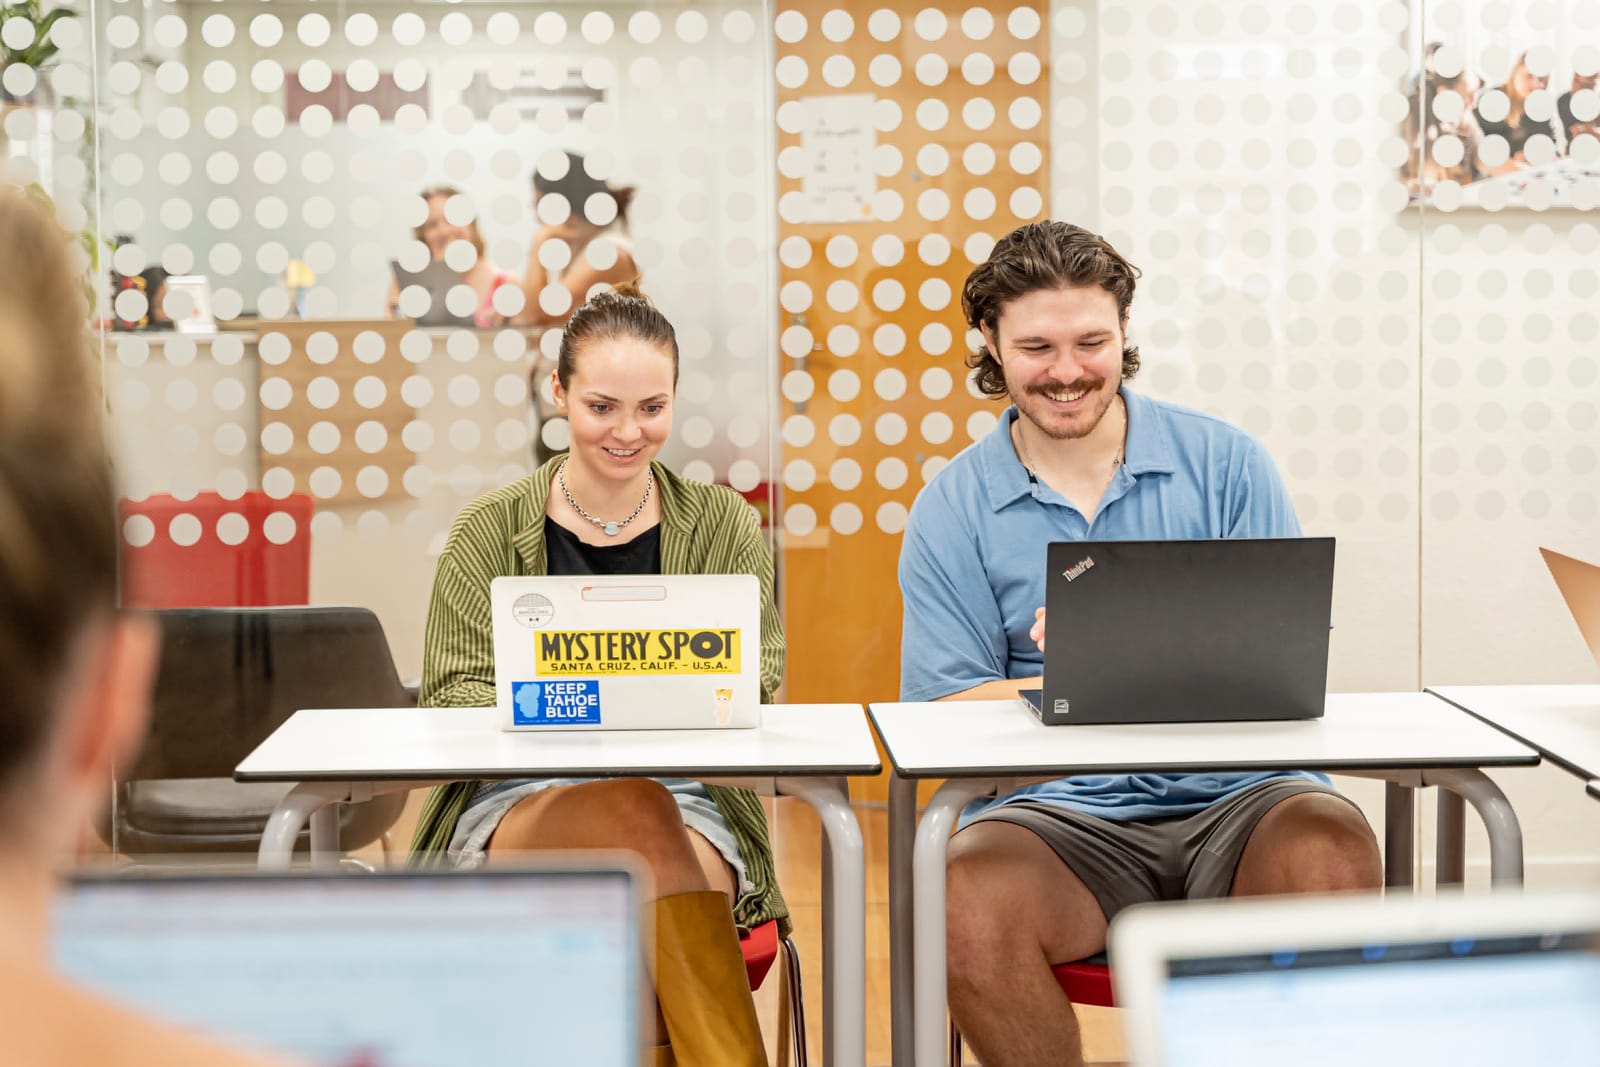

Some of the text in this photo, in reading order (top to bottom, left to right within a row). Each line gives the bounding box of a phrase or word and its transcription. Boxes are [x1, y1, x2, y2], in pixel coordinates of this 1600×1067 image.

[1062, 555, 1095, 582] ThinkPad
[541, 630, 736, 661] MYSTERY SPOT
[551, 662, 593, 671] SANTA
[640, 661, 678, 670] CALIF.
[692, 661, 728, 670] U.S.A.
[544, 682, 587, 695] KEEP
[544, 694, 598, 706] TAHOE
[545, 706, 588, 718] BLUE
